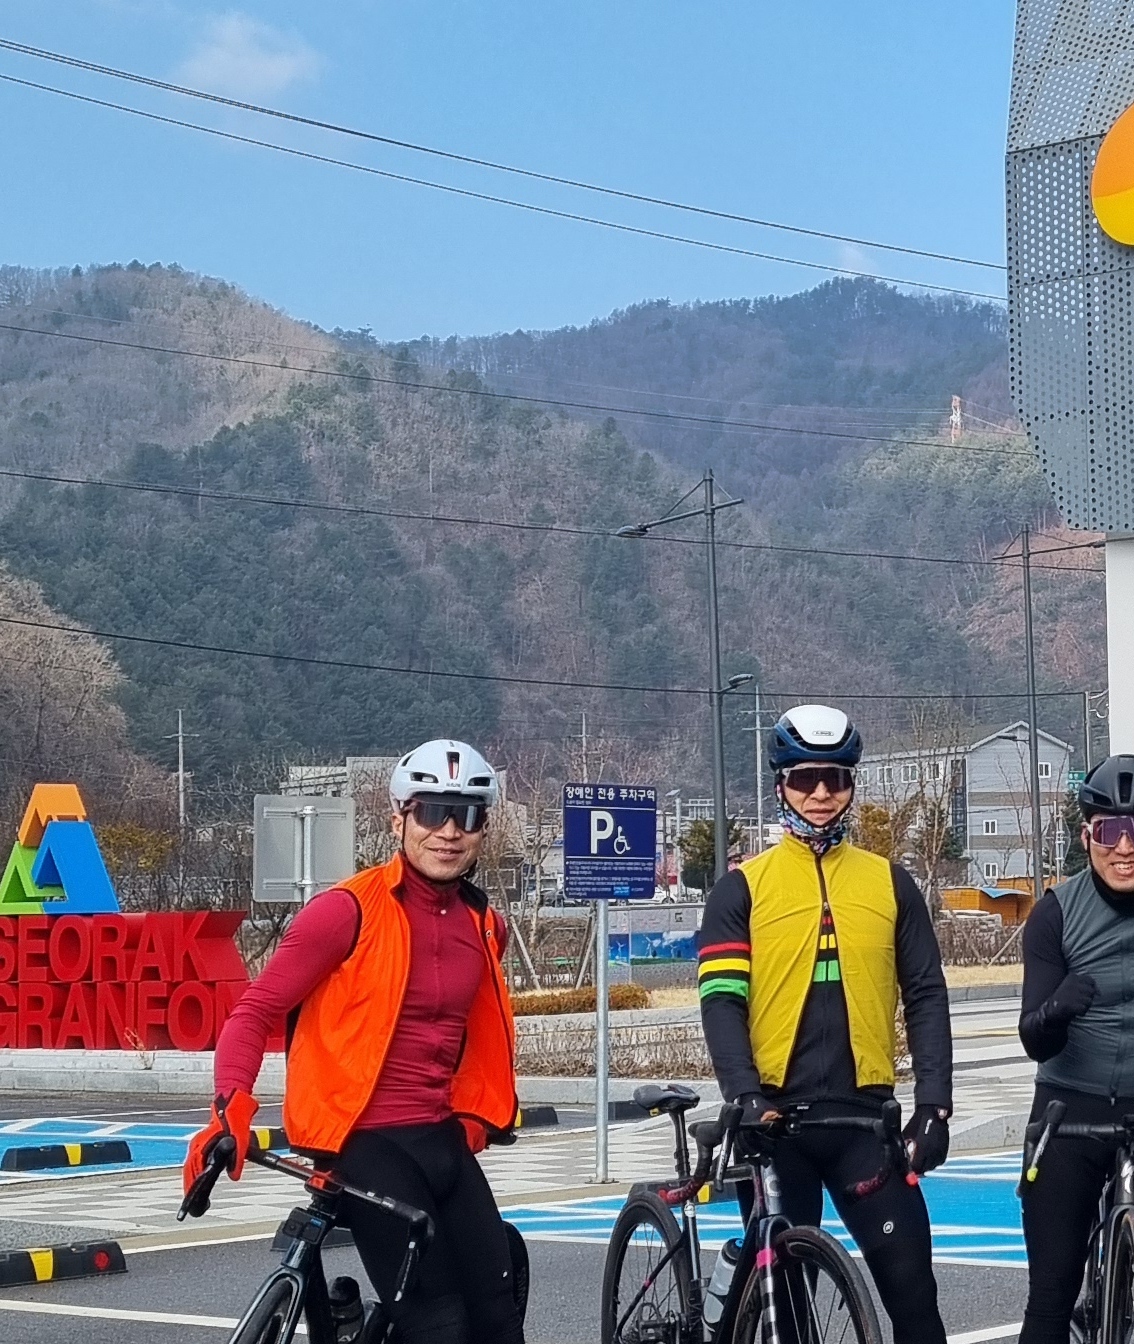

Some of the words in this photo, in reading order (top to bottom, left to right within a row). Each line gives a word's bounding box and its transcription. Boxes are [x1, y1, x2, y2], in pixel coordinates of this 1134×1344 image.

[565, 786, 594, 800] 장애인
[597, 787, 615, 801] 전용
[619, 788, 656, 802] 주차구역
[591, 810, 614, 854] P
